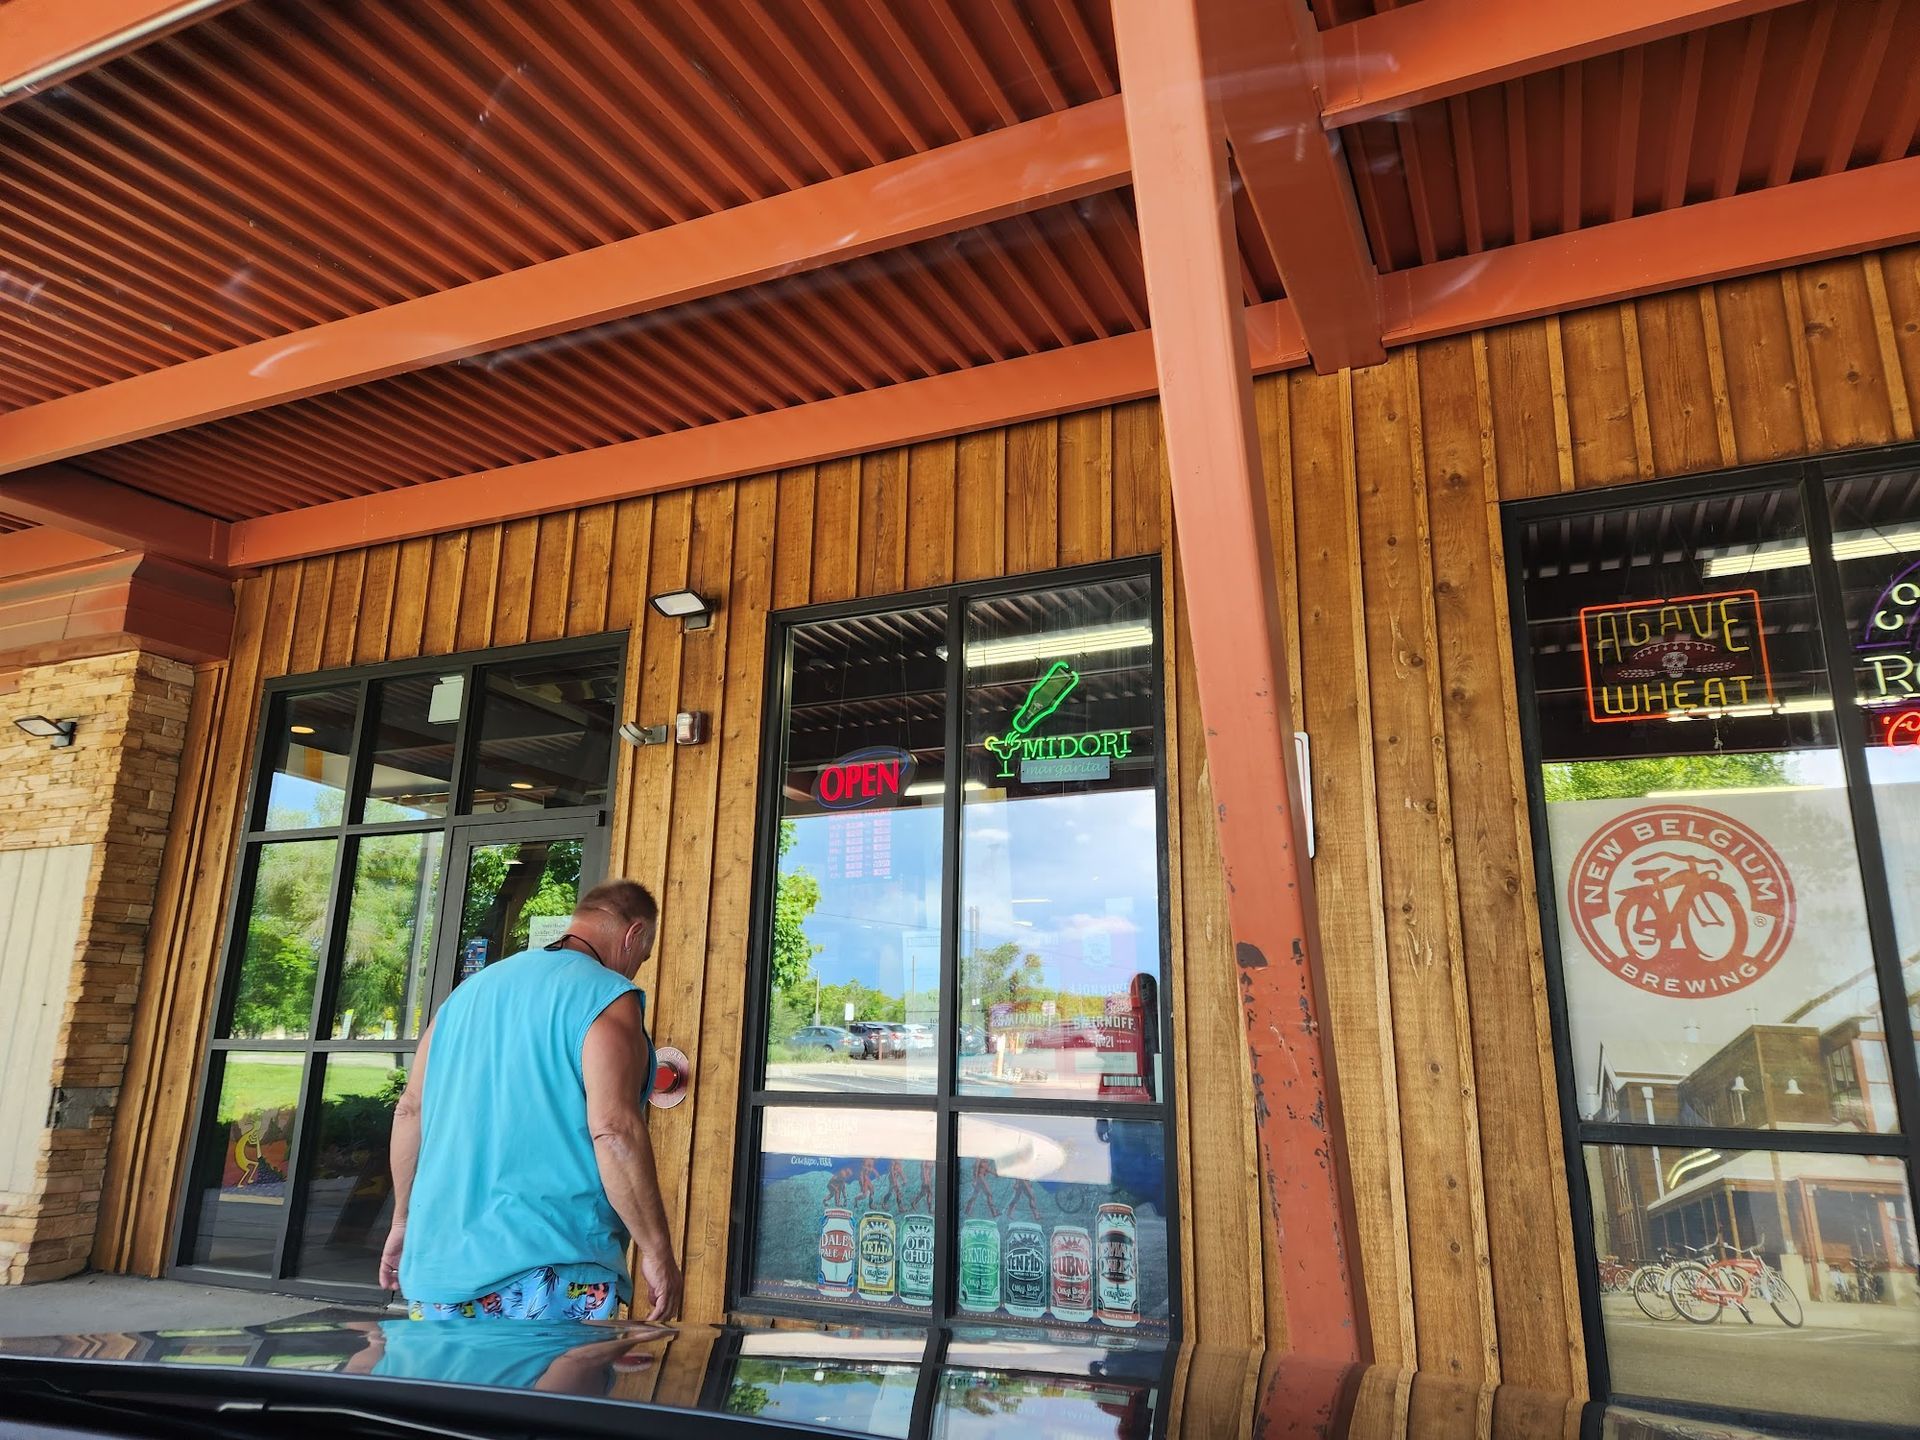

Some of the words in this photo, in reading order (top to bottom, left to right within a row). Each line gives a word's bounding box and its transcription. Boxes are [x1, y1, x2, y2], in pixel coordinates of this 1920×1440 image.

[1596, 597, 1750, 664] AGAVE
[1862, 654, 1920, 696] R
[1602, 676, 1753, 714] WHEAT
[1022, 731, 1132, 760] MIDORI
[820, 759, 899, 801] OPEN
[1026, 761, 1104, 776] margarita
[1584, 838, 1624, 904] NEW
[1631, 818, 1778, 901] BELGIUM
[1619, 962, 1758, 993] BREWING
[1073, 1015, 1135, 1030] SMIRNOFF
[862, 1241, 893, 1255] YELLA
[906, 1236, 932, 1250] OLD
[1052, 1255, 1090, 1277] GUBNA
